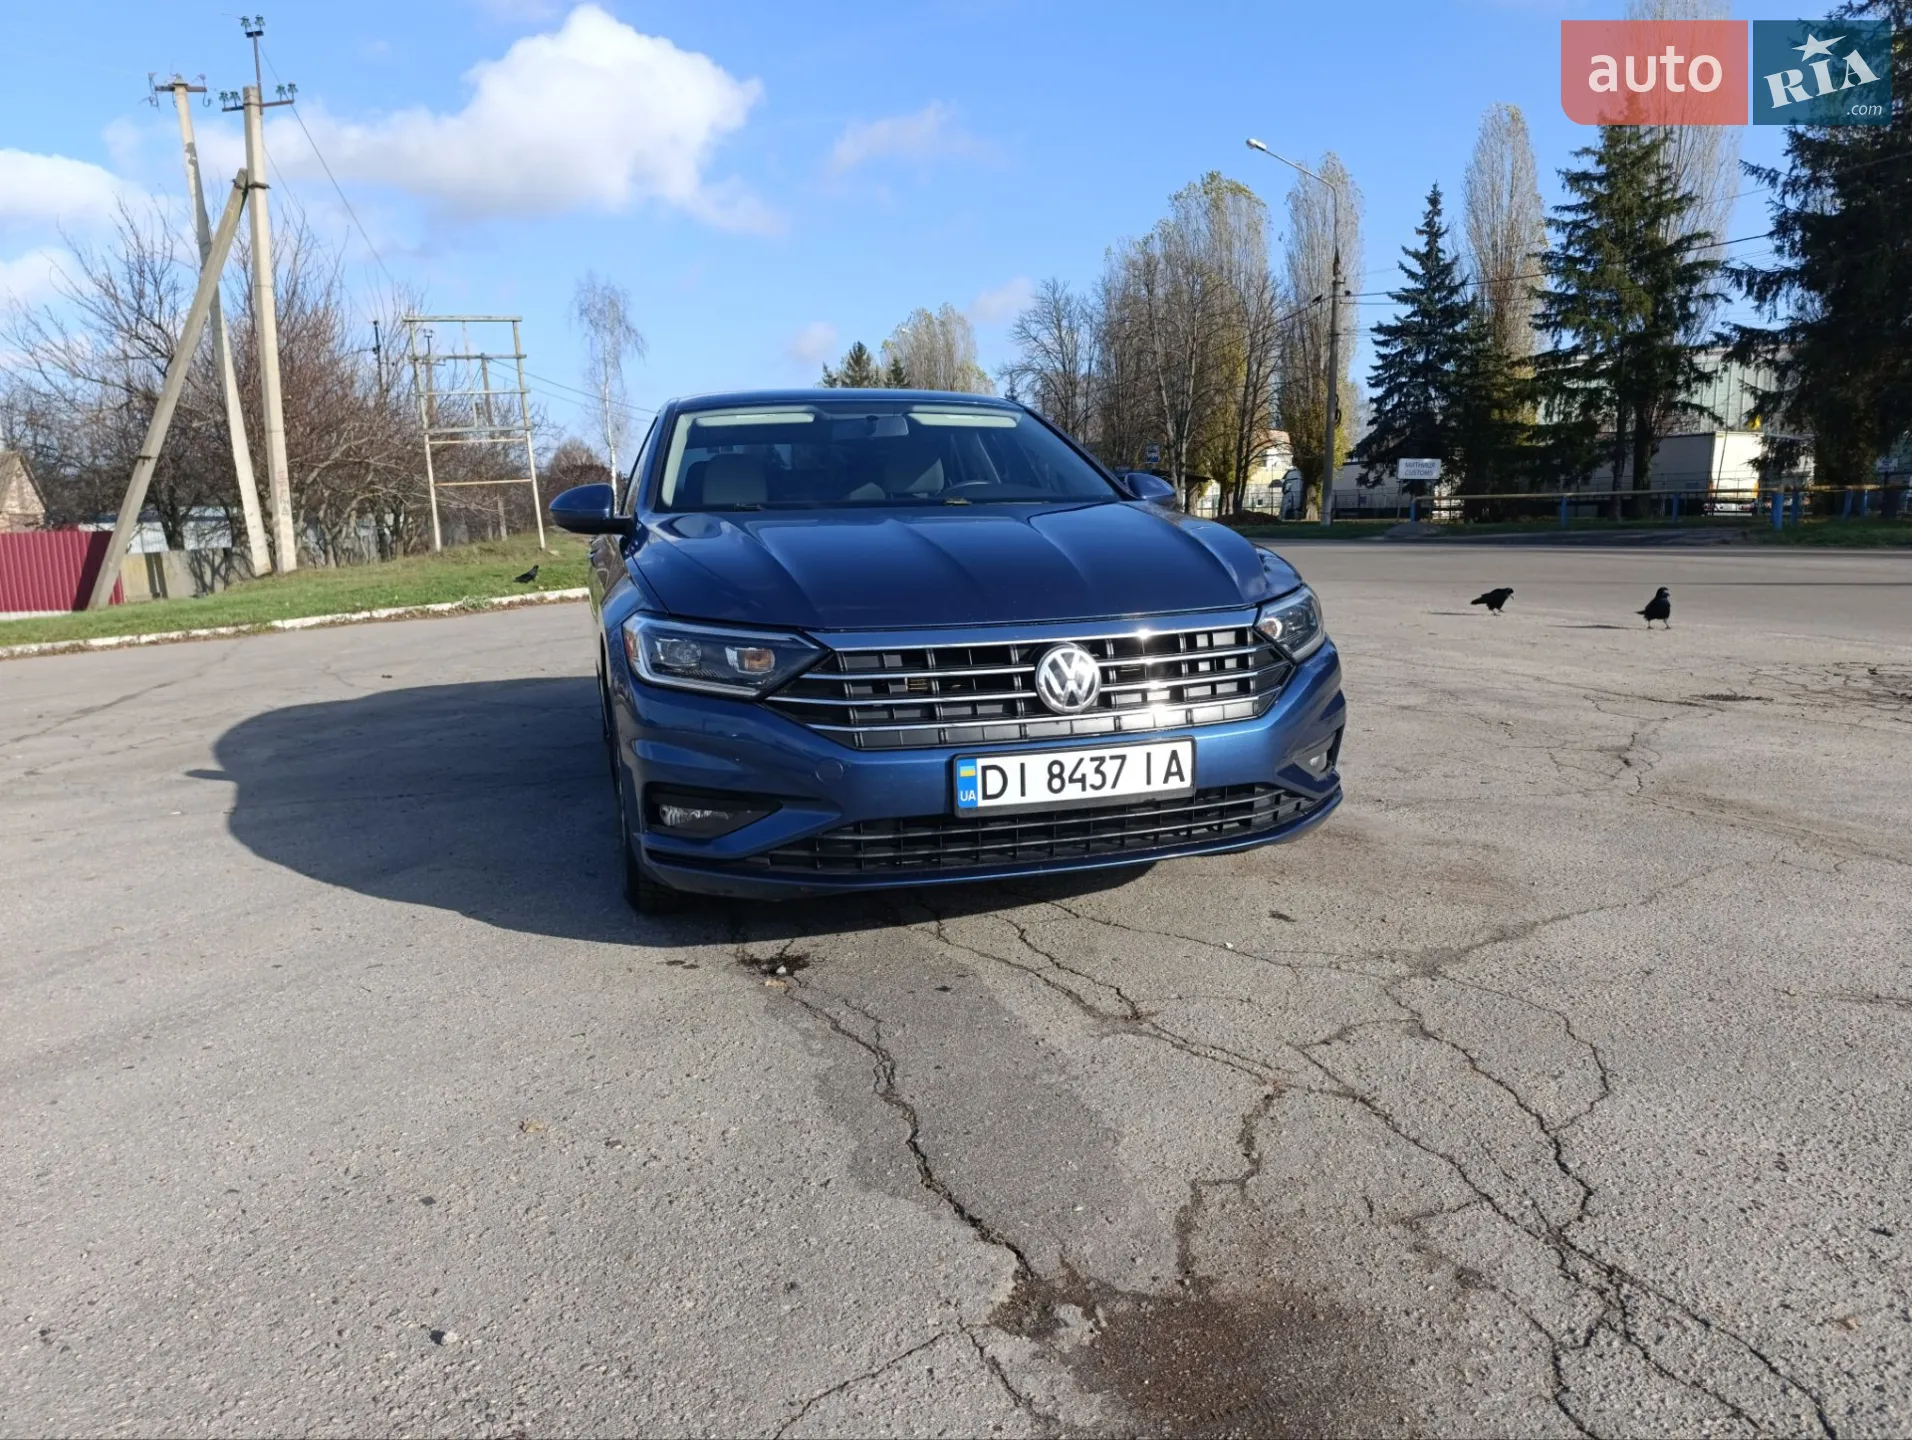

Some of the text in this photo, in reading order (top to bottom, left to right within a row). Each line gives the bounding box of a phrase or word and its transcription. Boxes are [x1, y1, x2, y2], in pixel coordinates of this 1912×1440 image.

[1404, 469, 1434, 477] CUSTOMS
[980, 749, 1186, 801] DI 8437 IA
[959, 789, 977, 802] UA
